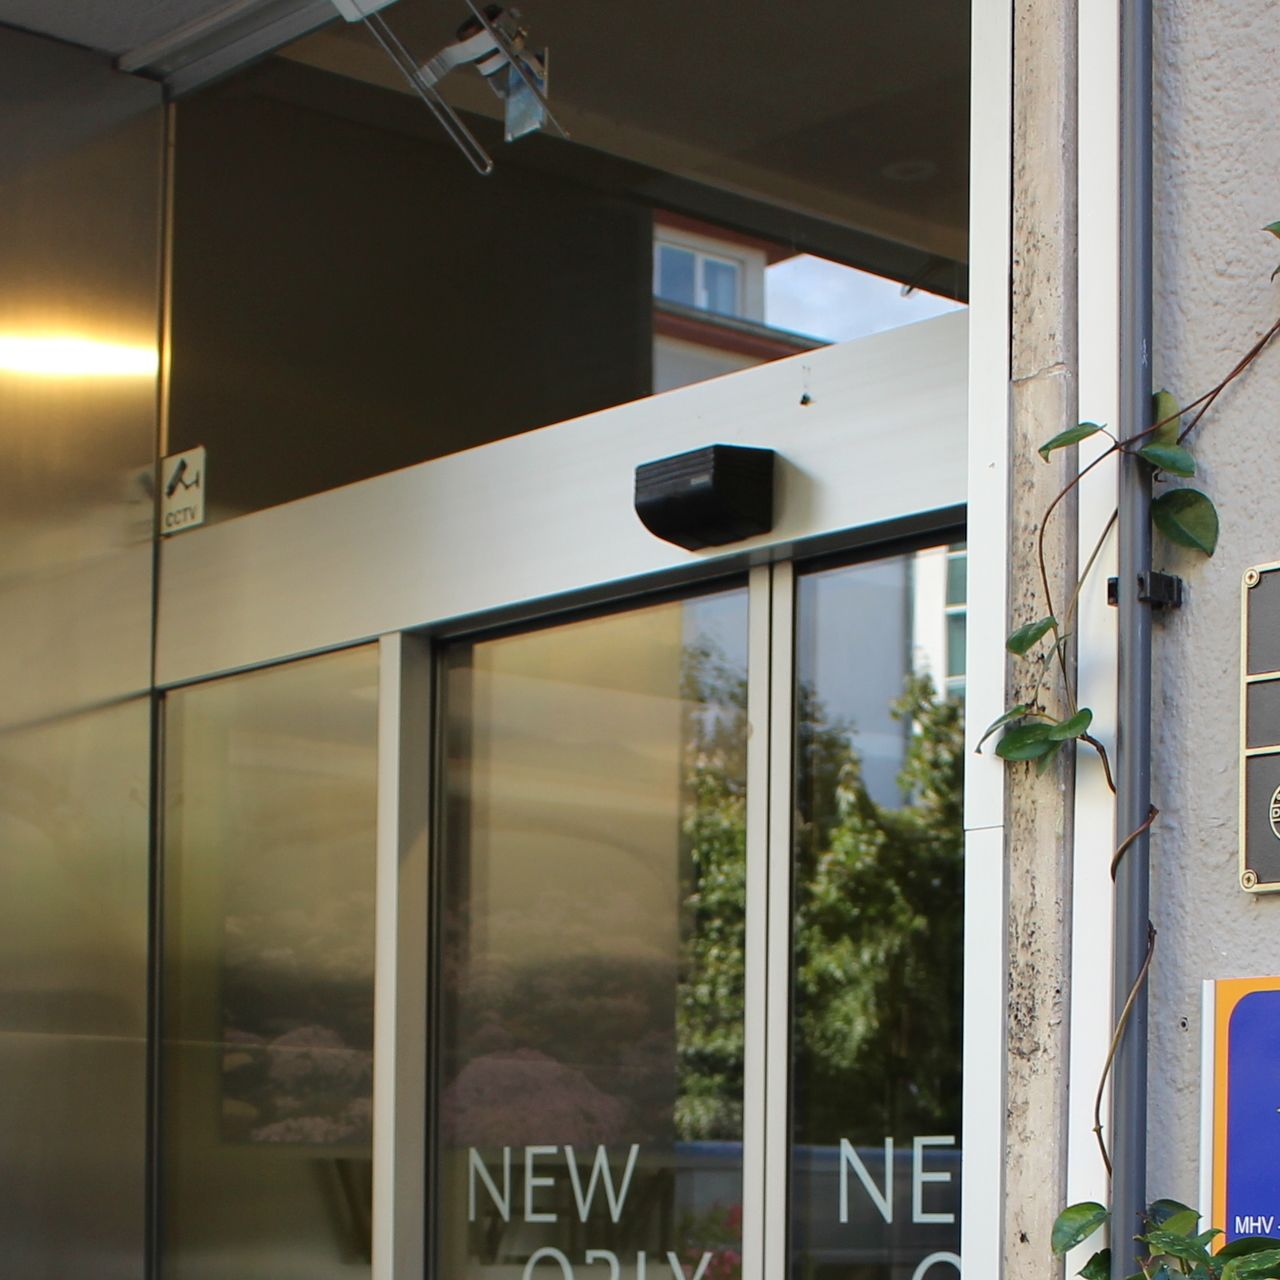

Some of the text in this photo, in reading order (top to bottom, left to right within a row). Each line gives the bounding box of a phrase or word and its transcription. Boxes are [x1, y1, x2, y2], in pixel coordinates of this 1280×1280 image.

[165, 505, 197, 527] CCTV
[468, 1143, 641, 1224] NEW
[1235, 1216, 1274, 1234] MHV
